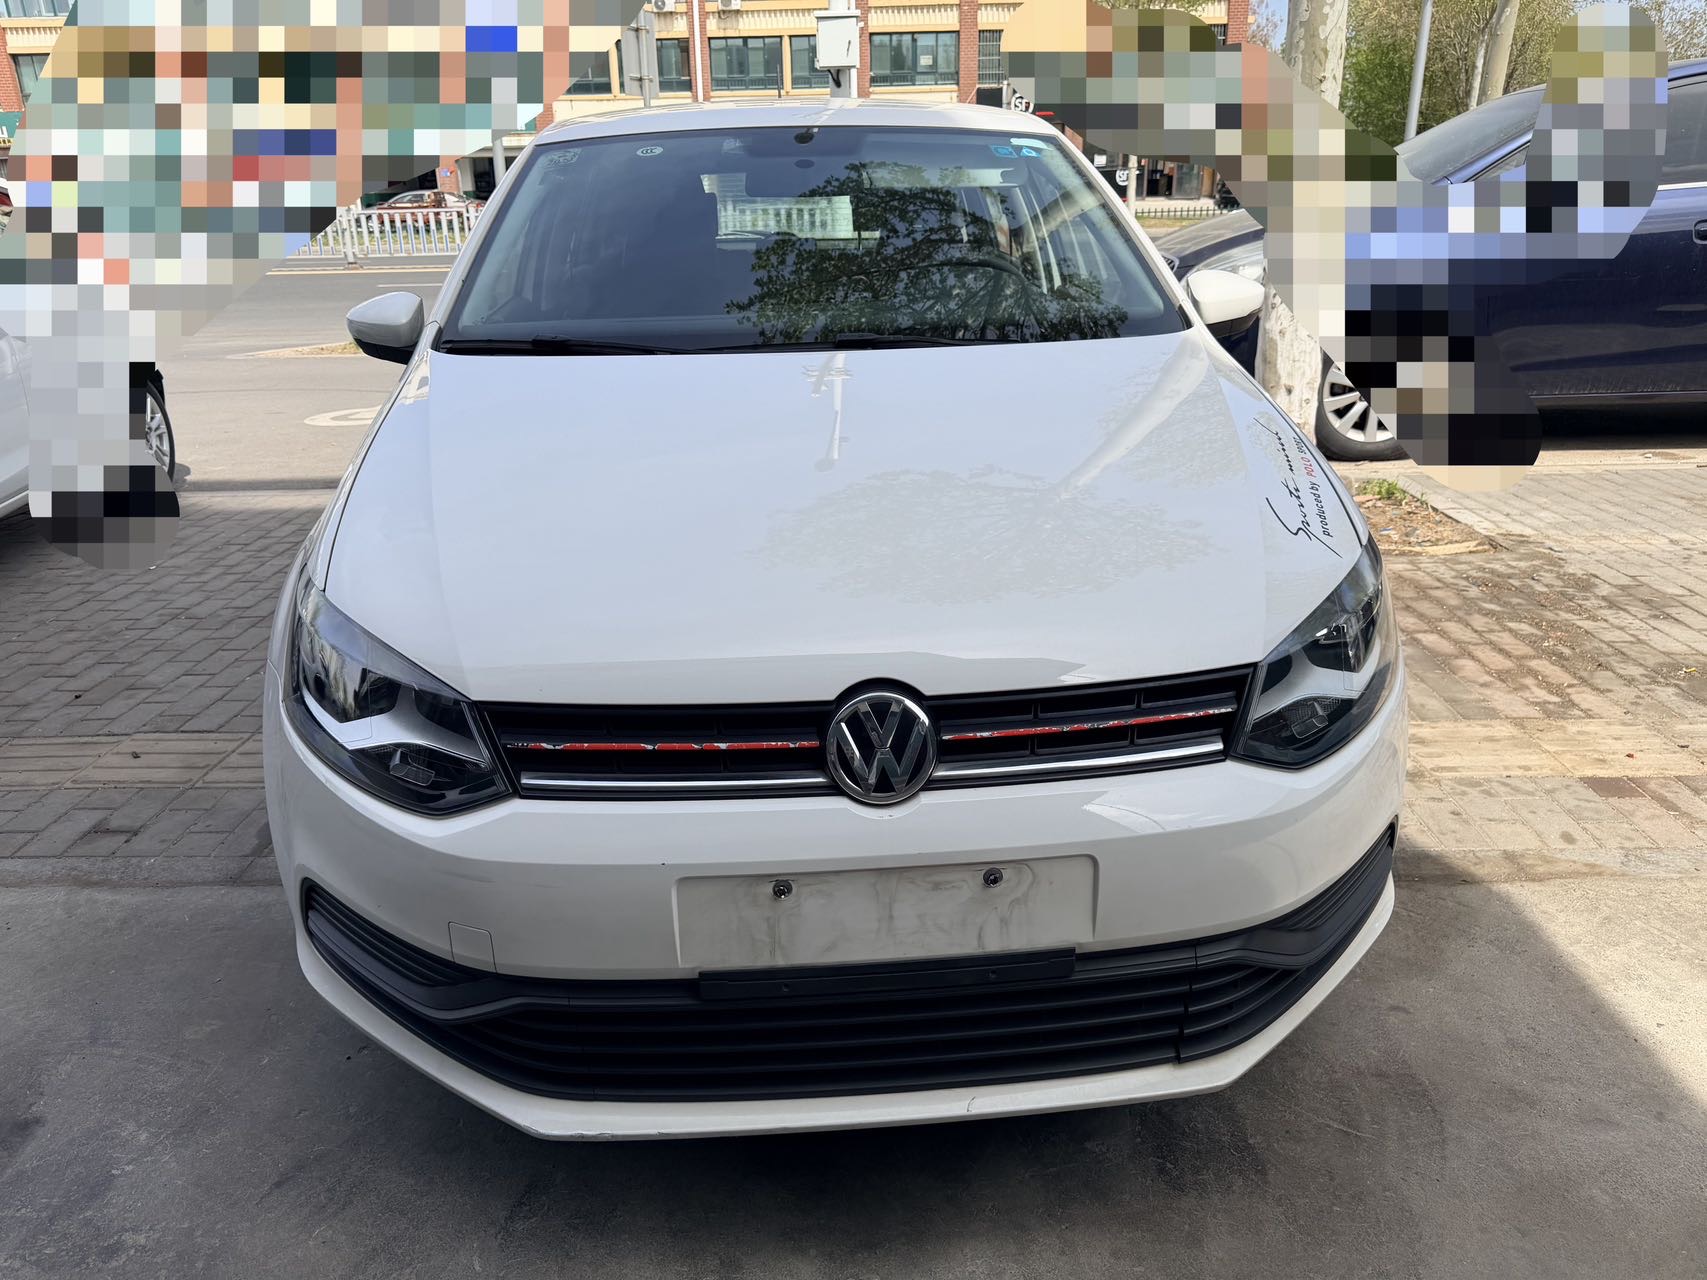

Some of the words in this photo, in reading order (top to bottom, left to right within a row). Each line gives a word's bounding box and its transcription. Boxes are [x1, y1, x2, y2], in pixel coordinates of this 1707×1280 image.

[1293, 436, 1306, 454] SPORT
[1301, 456, 1317, 478] POLO
[1308, 481, 1321, 491] by
[1310, 491, 1333, 538] produced
